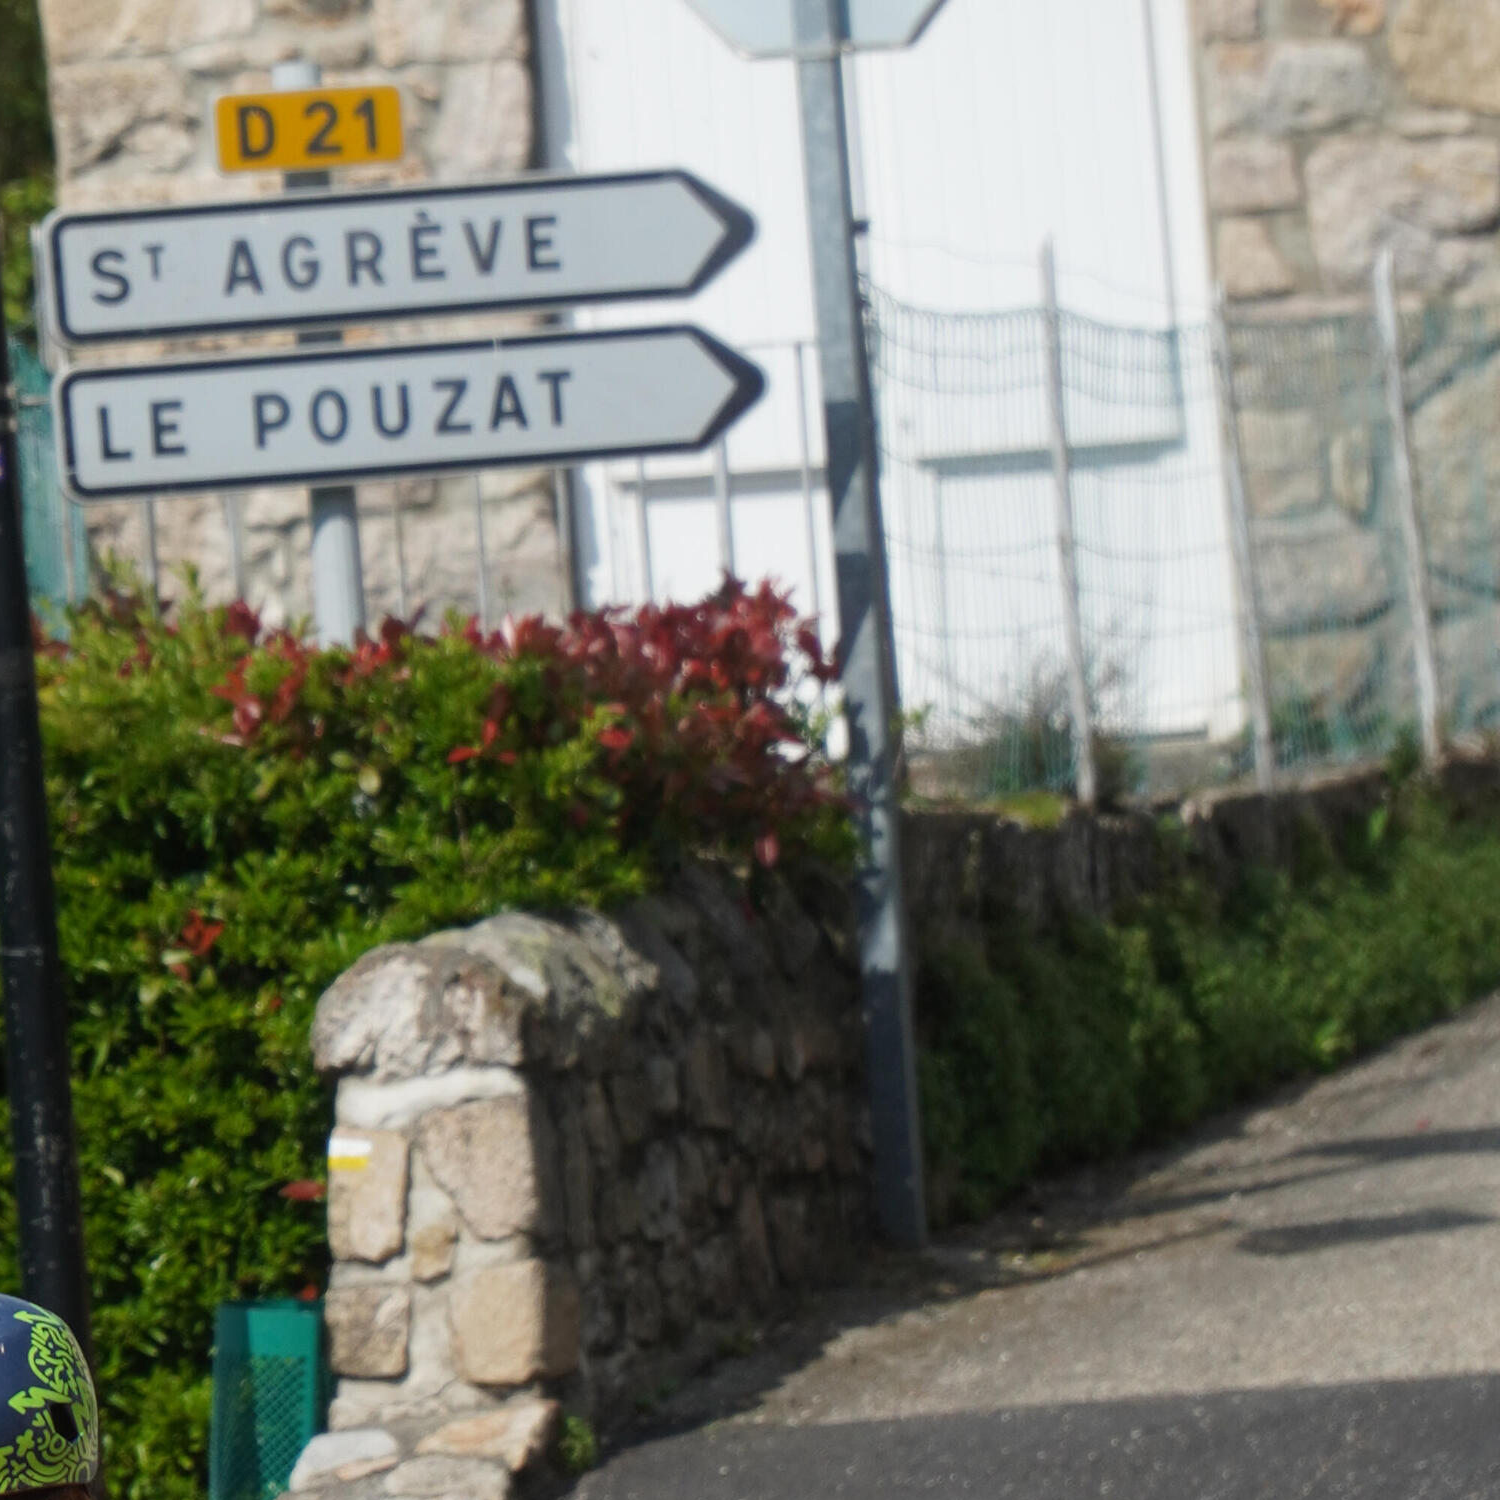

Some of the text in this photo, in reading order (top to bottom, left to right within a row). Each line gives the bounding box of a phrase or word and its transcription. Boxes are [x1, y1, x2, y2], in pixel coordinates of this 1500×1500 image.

[237, 98, 379, 160] D 21
[225, 211, 561, 295] AGRÈVE
[99, 370, 572, 462] LE POUZAT
